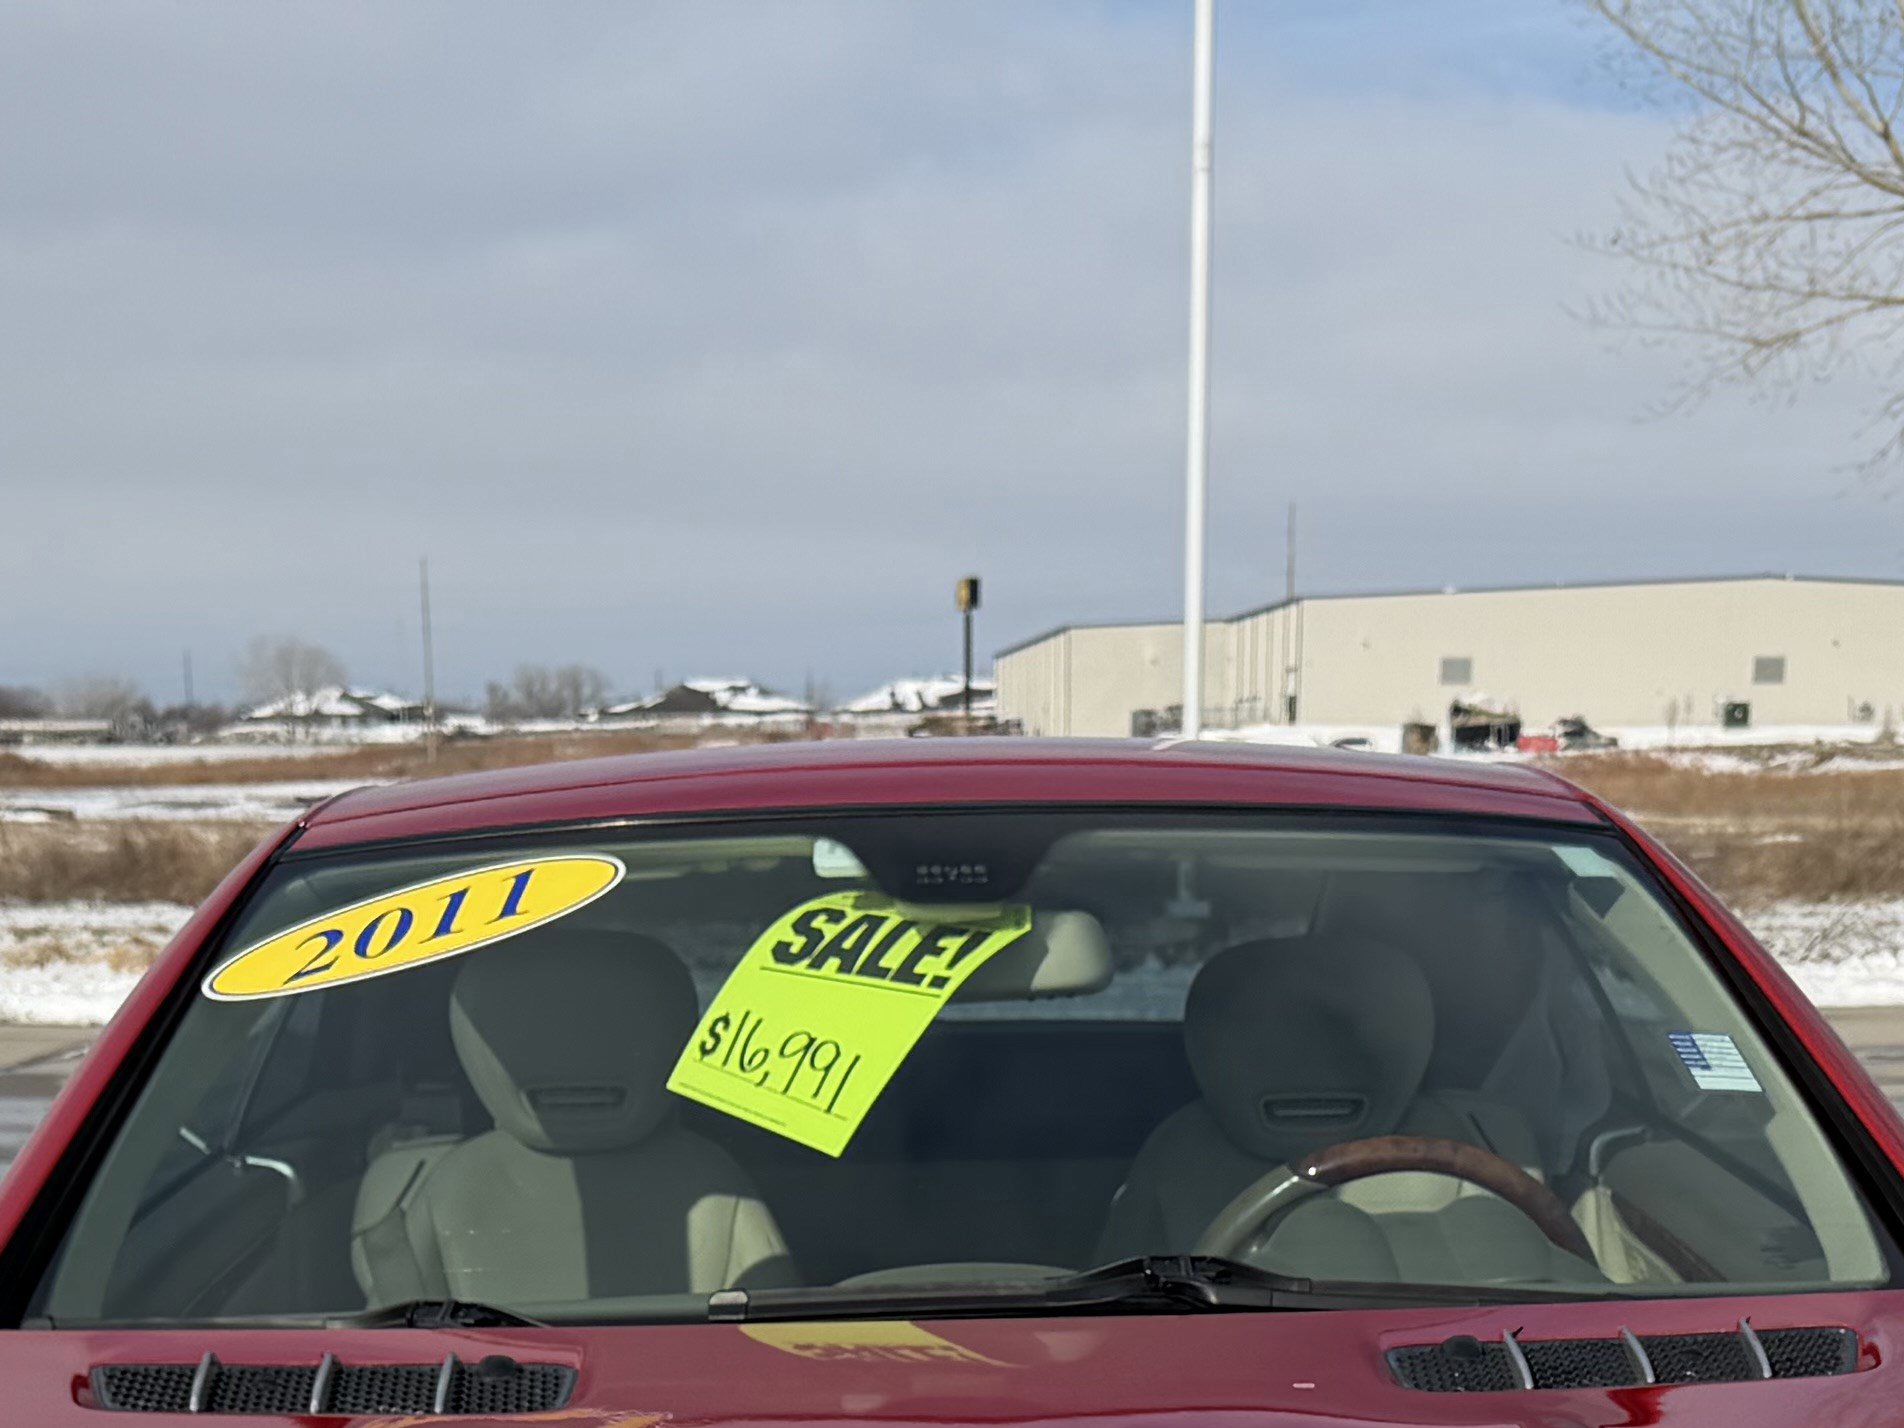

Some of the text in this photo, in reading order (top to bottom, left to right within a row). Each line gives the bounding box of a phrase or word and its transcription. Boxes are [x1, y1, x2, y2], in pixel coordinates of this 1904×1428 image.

[281, 866, 538, 987] 2011
[769, 906, 993, 990] SALE!
[698, 1009, 861, 1114] $16,991
